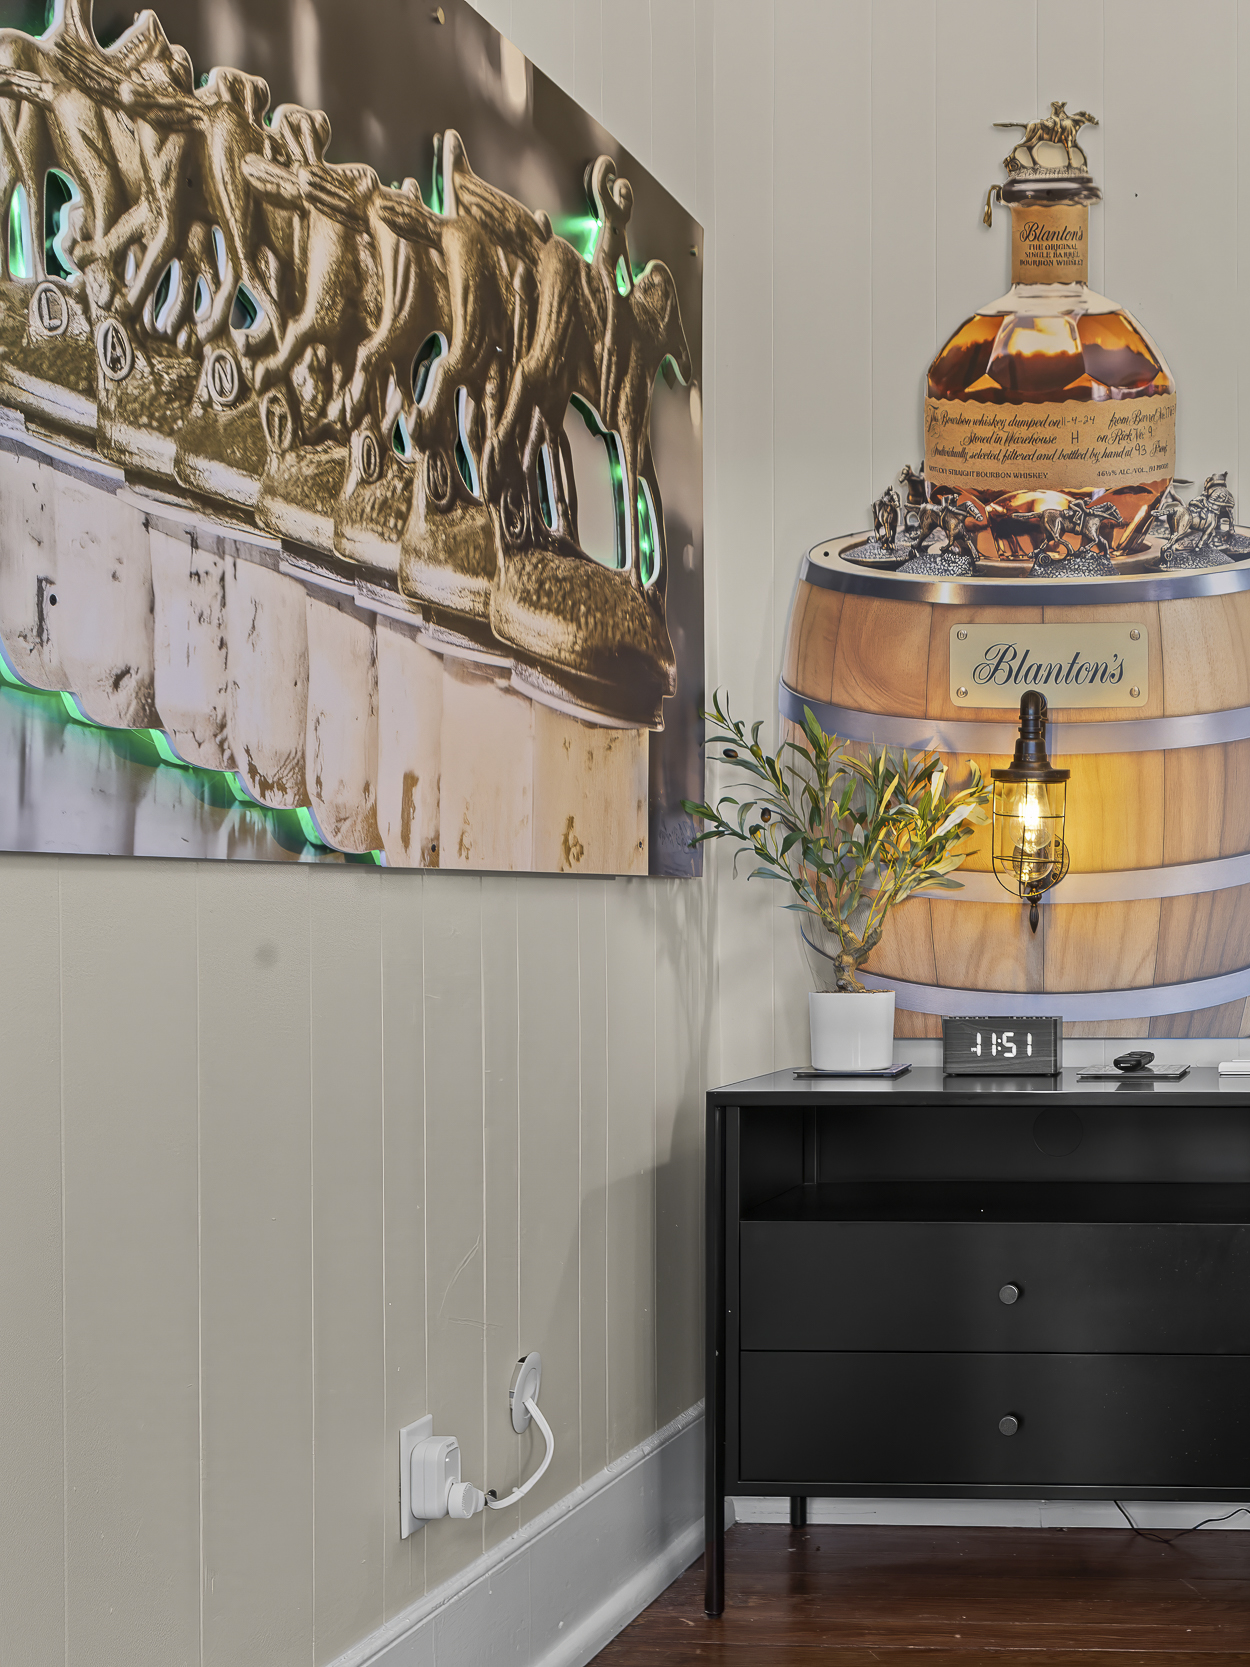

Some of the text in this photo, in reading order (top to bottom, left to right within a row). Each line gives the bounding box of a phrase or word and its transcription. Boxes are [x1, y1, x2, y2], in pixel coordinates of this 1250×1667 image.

[1019, 221, 1084, 242] Blanton's
[1008, 414, 1050, 430] dumped
[1071, 430, 1079, 444] H
[972, 643, 1124, 685] Blanton's
[976, 1032, 1032, 1057] 11:51
